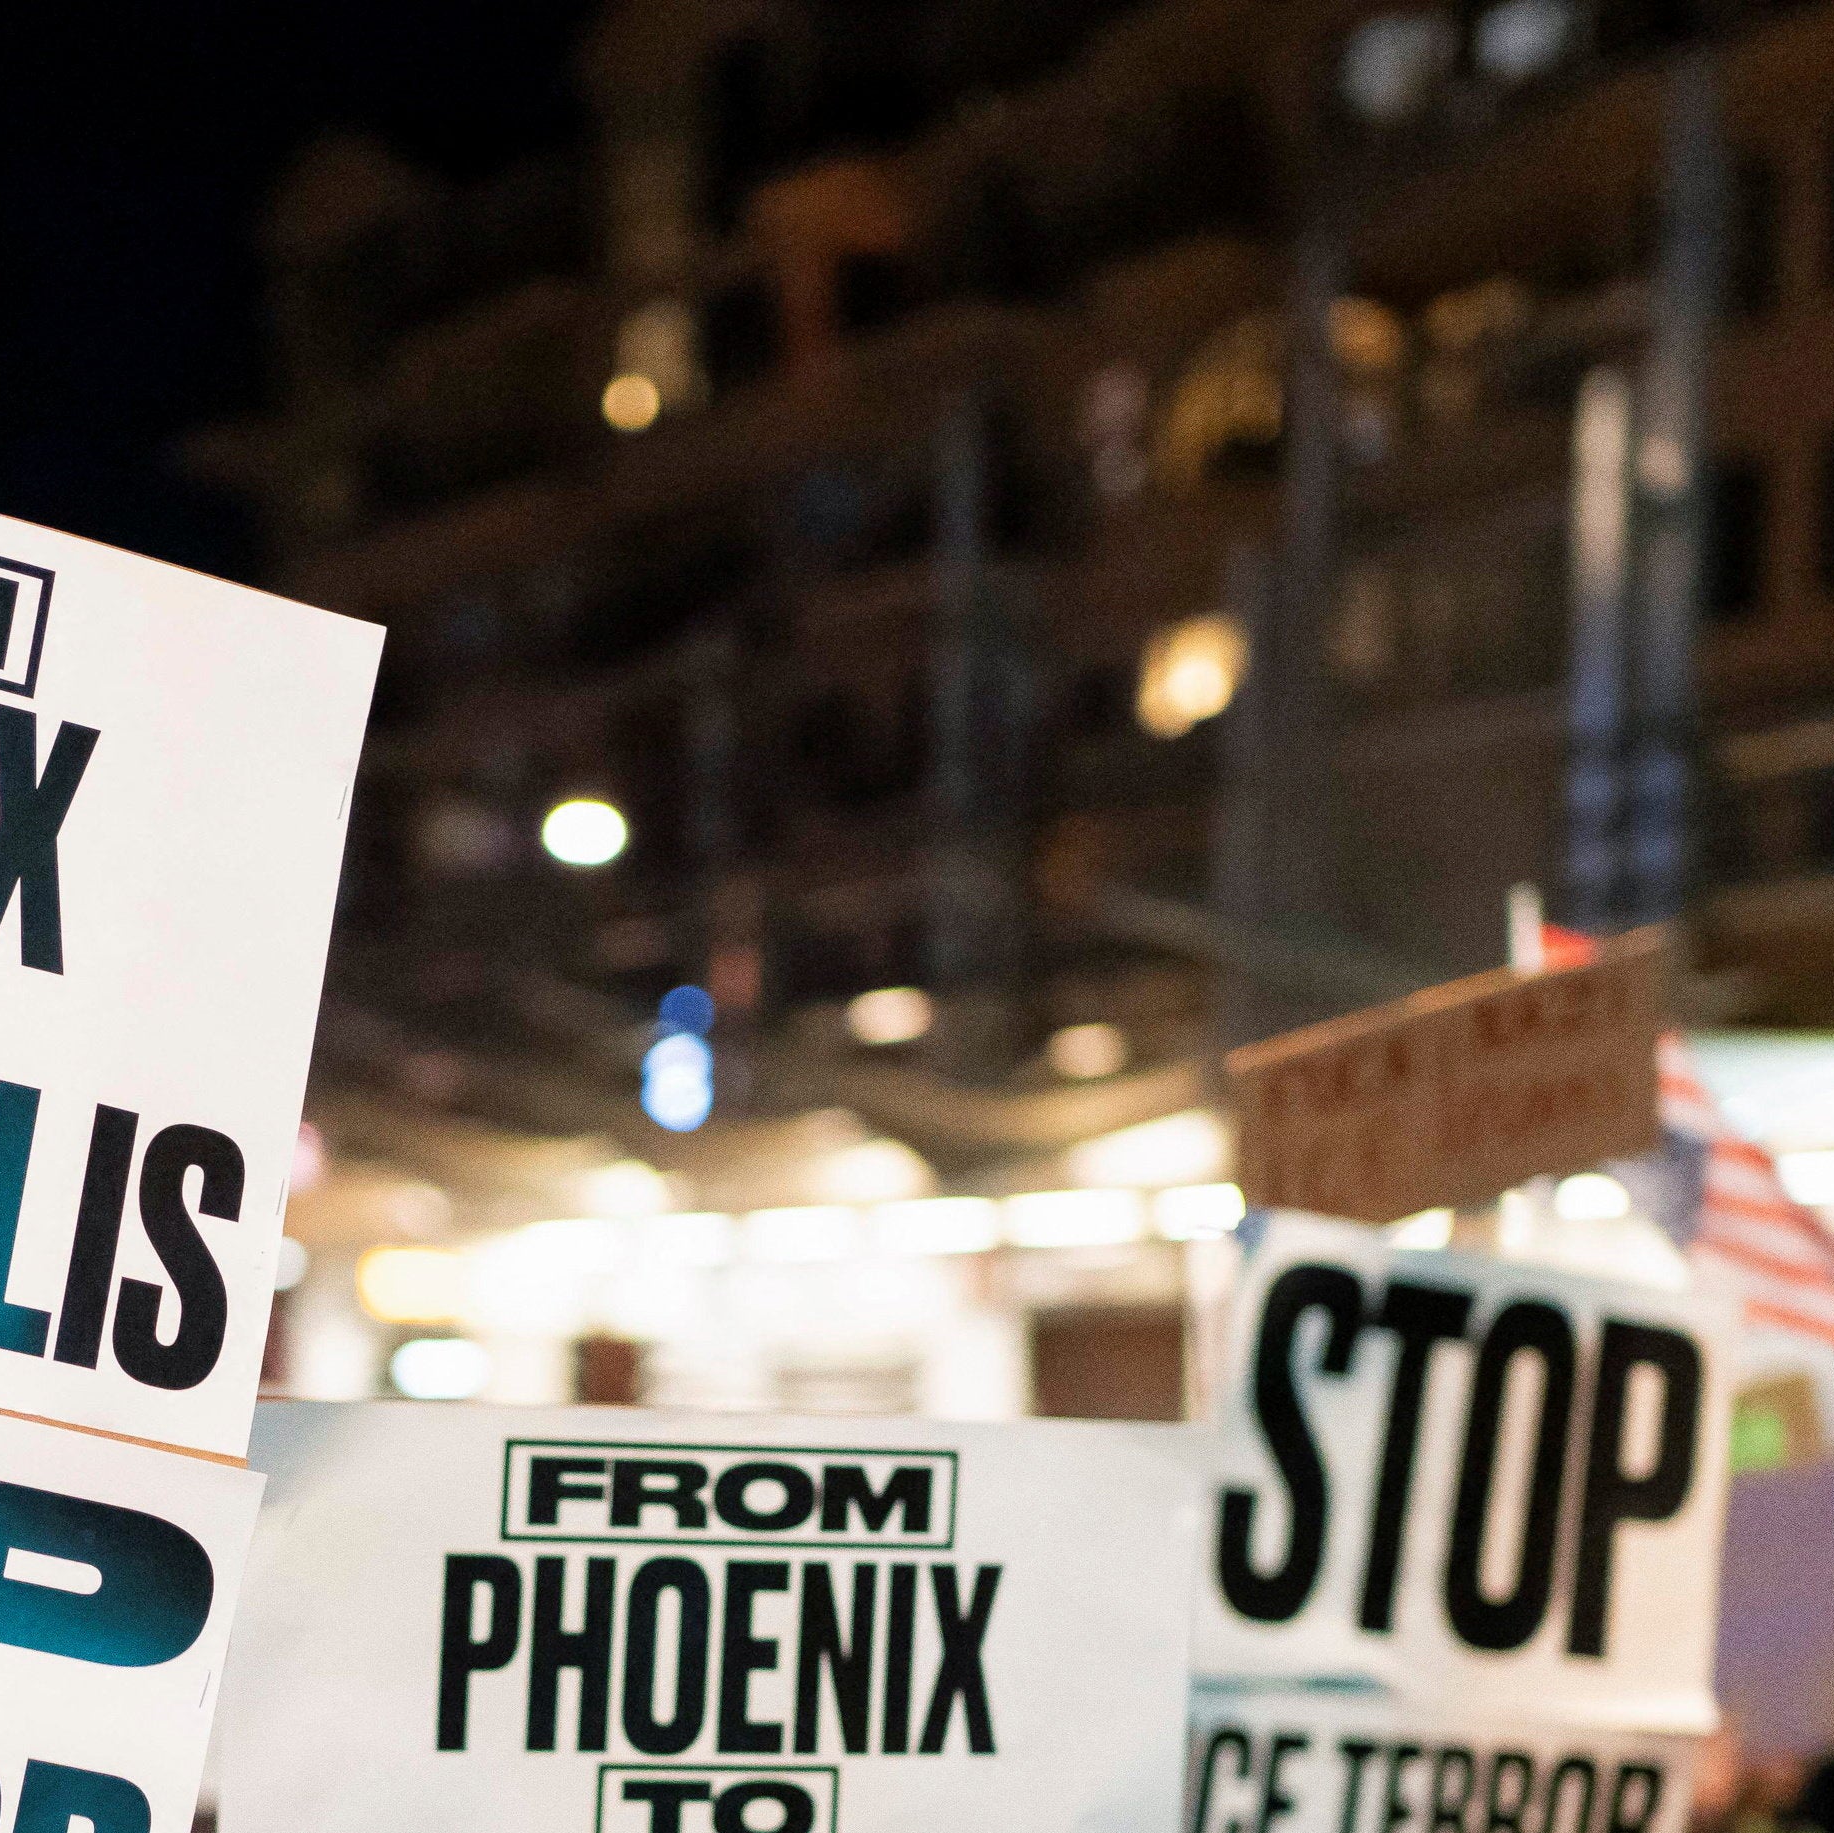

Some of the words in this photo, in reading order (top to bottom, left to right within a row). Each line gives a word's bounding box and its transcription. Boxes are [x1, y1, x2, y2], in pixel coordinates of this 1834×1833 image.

[527, 1456, 934, 1535] FROM
[1217, 1262, 1703, 1660] STOP
[436, 1553, 1003, 1756] PHOENIX
